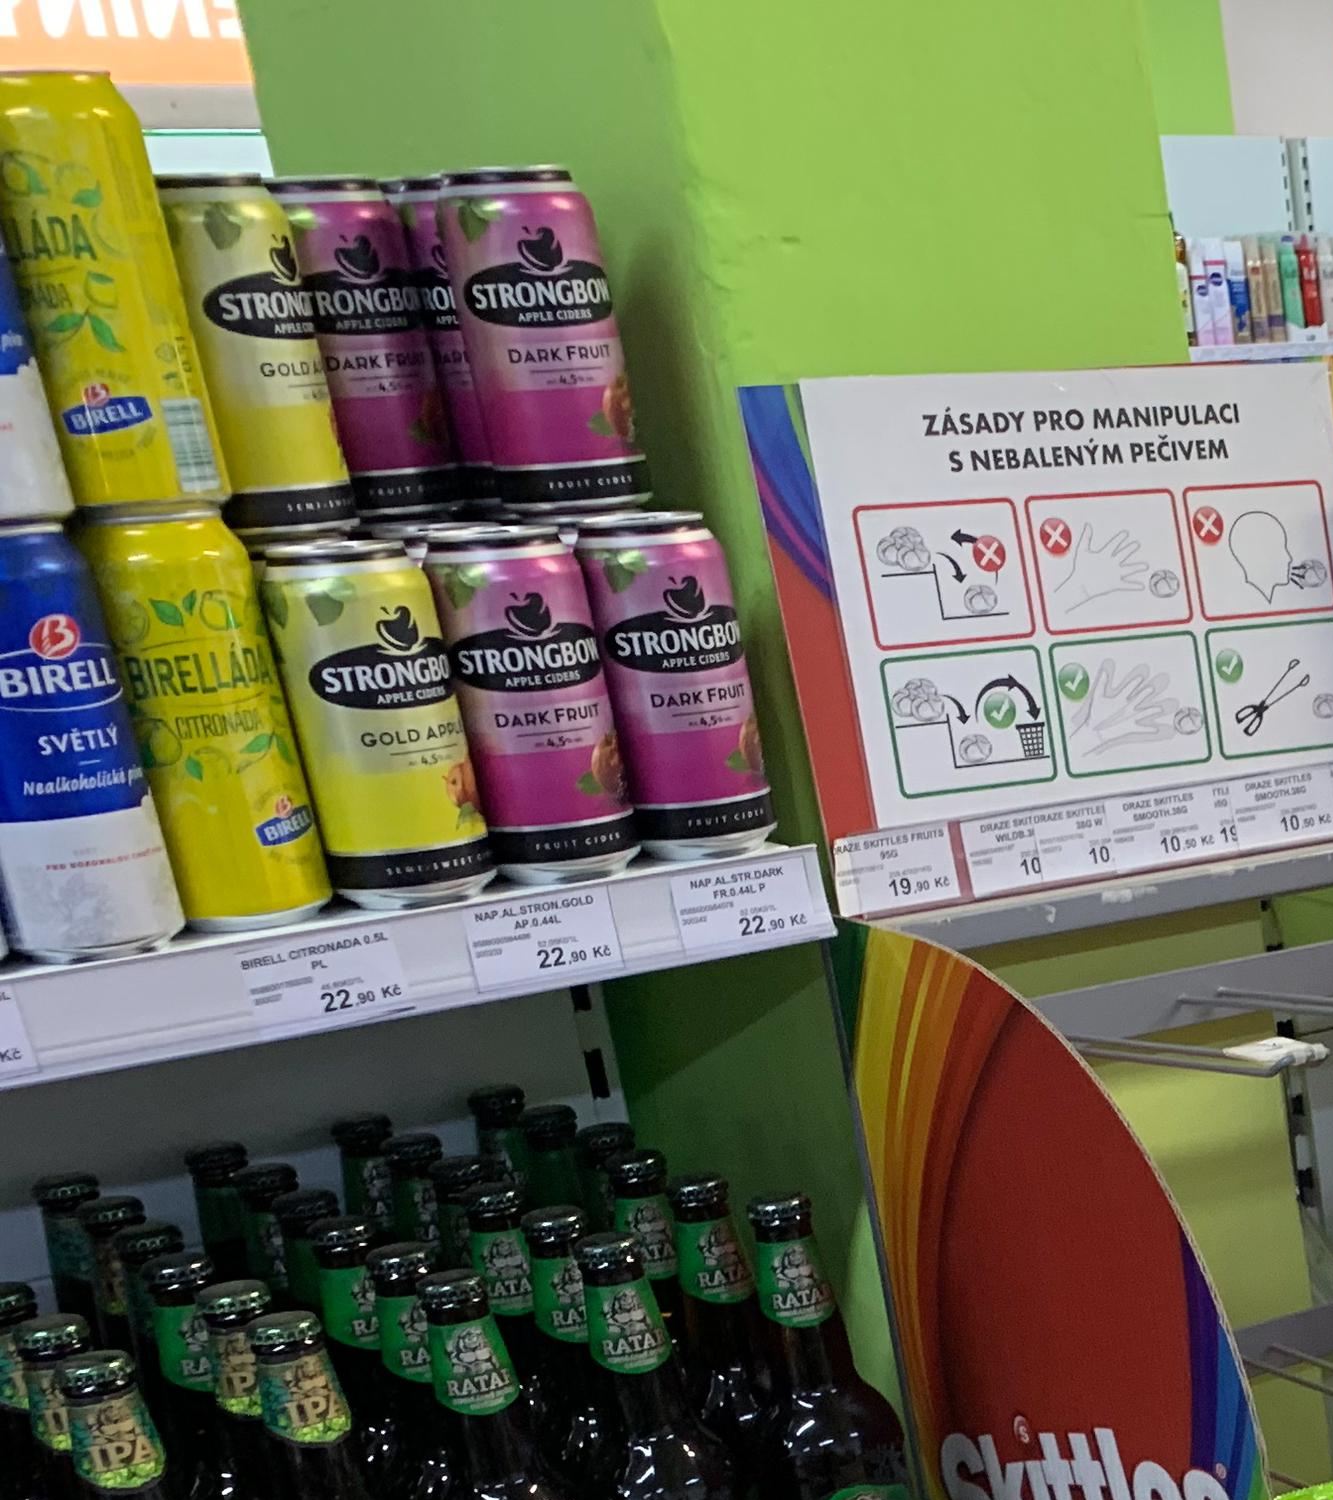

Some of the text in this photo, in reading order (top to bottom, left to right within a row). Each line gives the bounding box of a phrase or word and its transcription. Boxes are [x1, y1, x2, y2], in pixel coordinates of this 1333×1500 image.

[471, 276, 611, 311] STRONGBOW
[518, 307, 592, 323] APPLE CIDERS
[325, 352, 380, 373] DARK
[507, 343, 612, 365] DARK FRUIT
[260, 361, 307, 379] GOLD
[70, 402, 142, 431] BIRELL
[922, 402, 1241, 437] ZÁSADY PRO MANIPULACI
[949, 434, 1230, 473] S NEBALENÝM PEČIVEM
[458, 636, 599, 676] STRONGBOW
[661, 651, 731, 669] APPLE CIDERS
[0, 656, 117, 699] BIRELL
[124, 640, 275, 701] BIRELLÁDA
[321, 653, 450, 695] STRONGBO
[504, 669, 581, 689] APPLE CIDERS
[376, 691, 414, 706] APPLE
[650, 683, 745, 709] DARK FRUIT
[494, 702, 600, 729] DARK FRUIT
[38, 723, 118, 756] SVĚTLÝ
[360, 728, 421, 748] GOLD
[1121, 801, 1152, 813] DRAZE
[263, 810, 311, 843] BIRELL
[979, 820, 1015, 834] DRAZE
[863, 827, 945, 852] SKITTLES FRUITS
[934, 876, 951, 889] Kč
[790, 913, 808, 927] Kč
[240, 952, 287, 971] BIRELL
[288, 936, 362, 962] CITRONADA
[592, 944, 612, 960] Kč
[311, 959, 328, 970] PL
[381, 982, 402, 999] Kč
[90, 1439, 161, 1472] IPA
